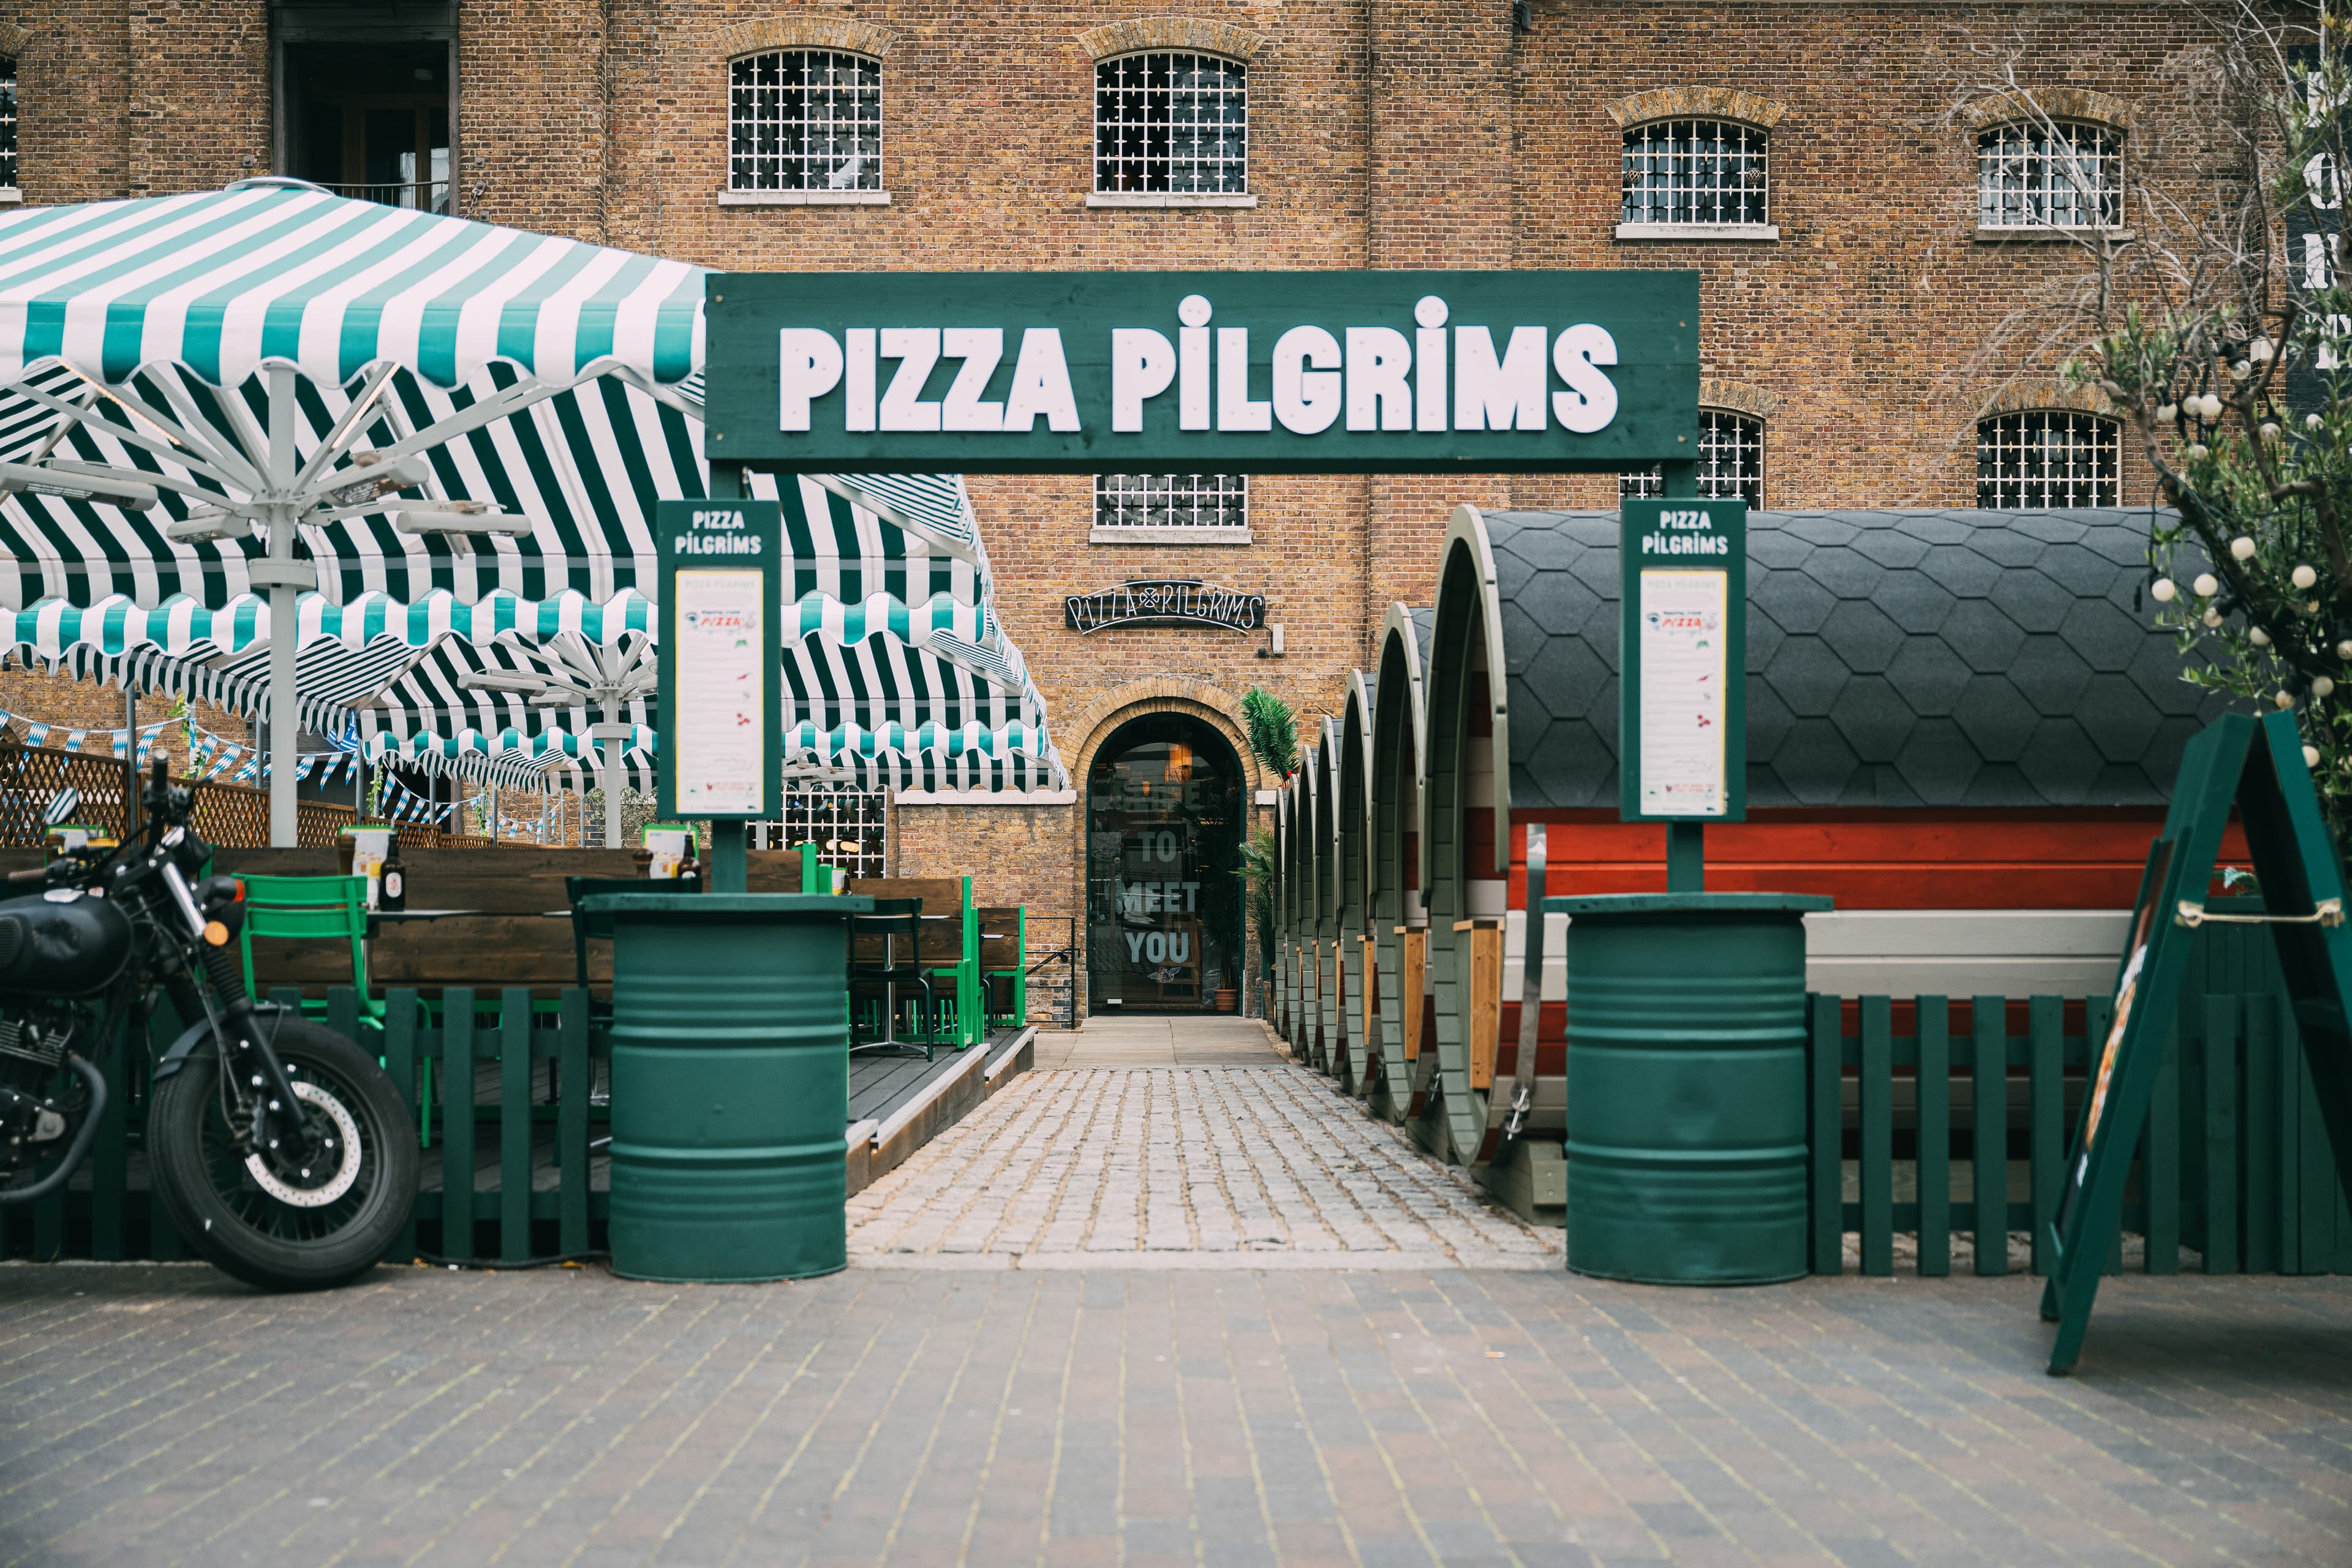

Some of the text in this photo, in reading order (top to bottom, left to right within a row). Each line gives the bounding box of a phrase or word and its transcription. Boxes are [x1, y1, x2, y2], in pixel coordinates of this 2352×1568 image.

[780, 295, 1618, 434] PIZZA PILGRIMS
[693, 511, 744, 529] PIZZA
[1660, 511, 1711, 529] PIZZA
[675, 531, 761, 554] PILGRIMS
[1643, 531, 1727, 554] PILGRIMS
[1068, 585, 1262, 630] PIZZA PILGRIMS
[1137, 831, 1177, 862] TO
[1115, 881, 1200, 912] MEET
[1125, 932, 1189, 963] YOU
